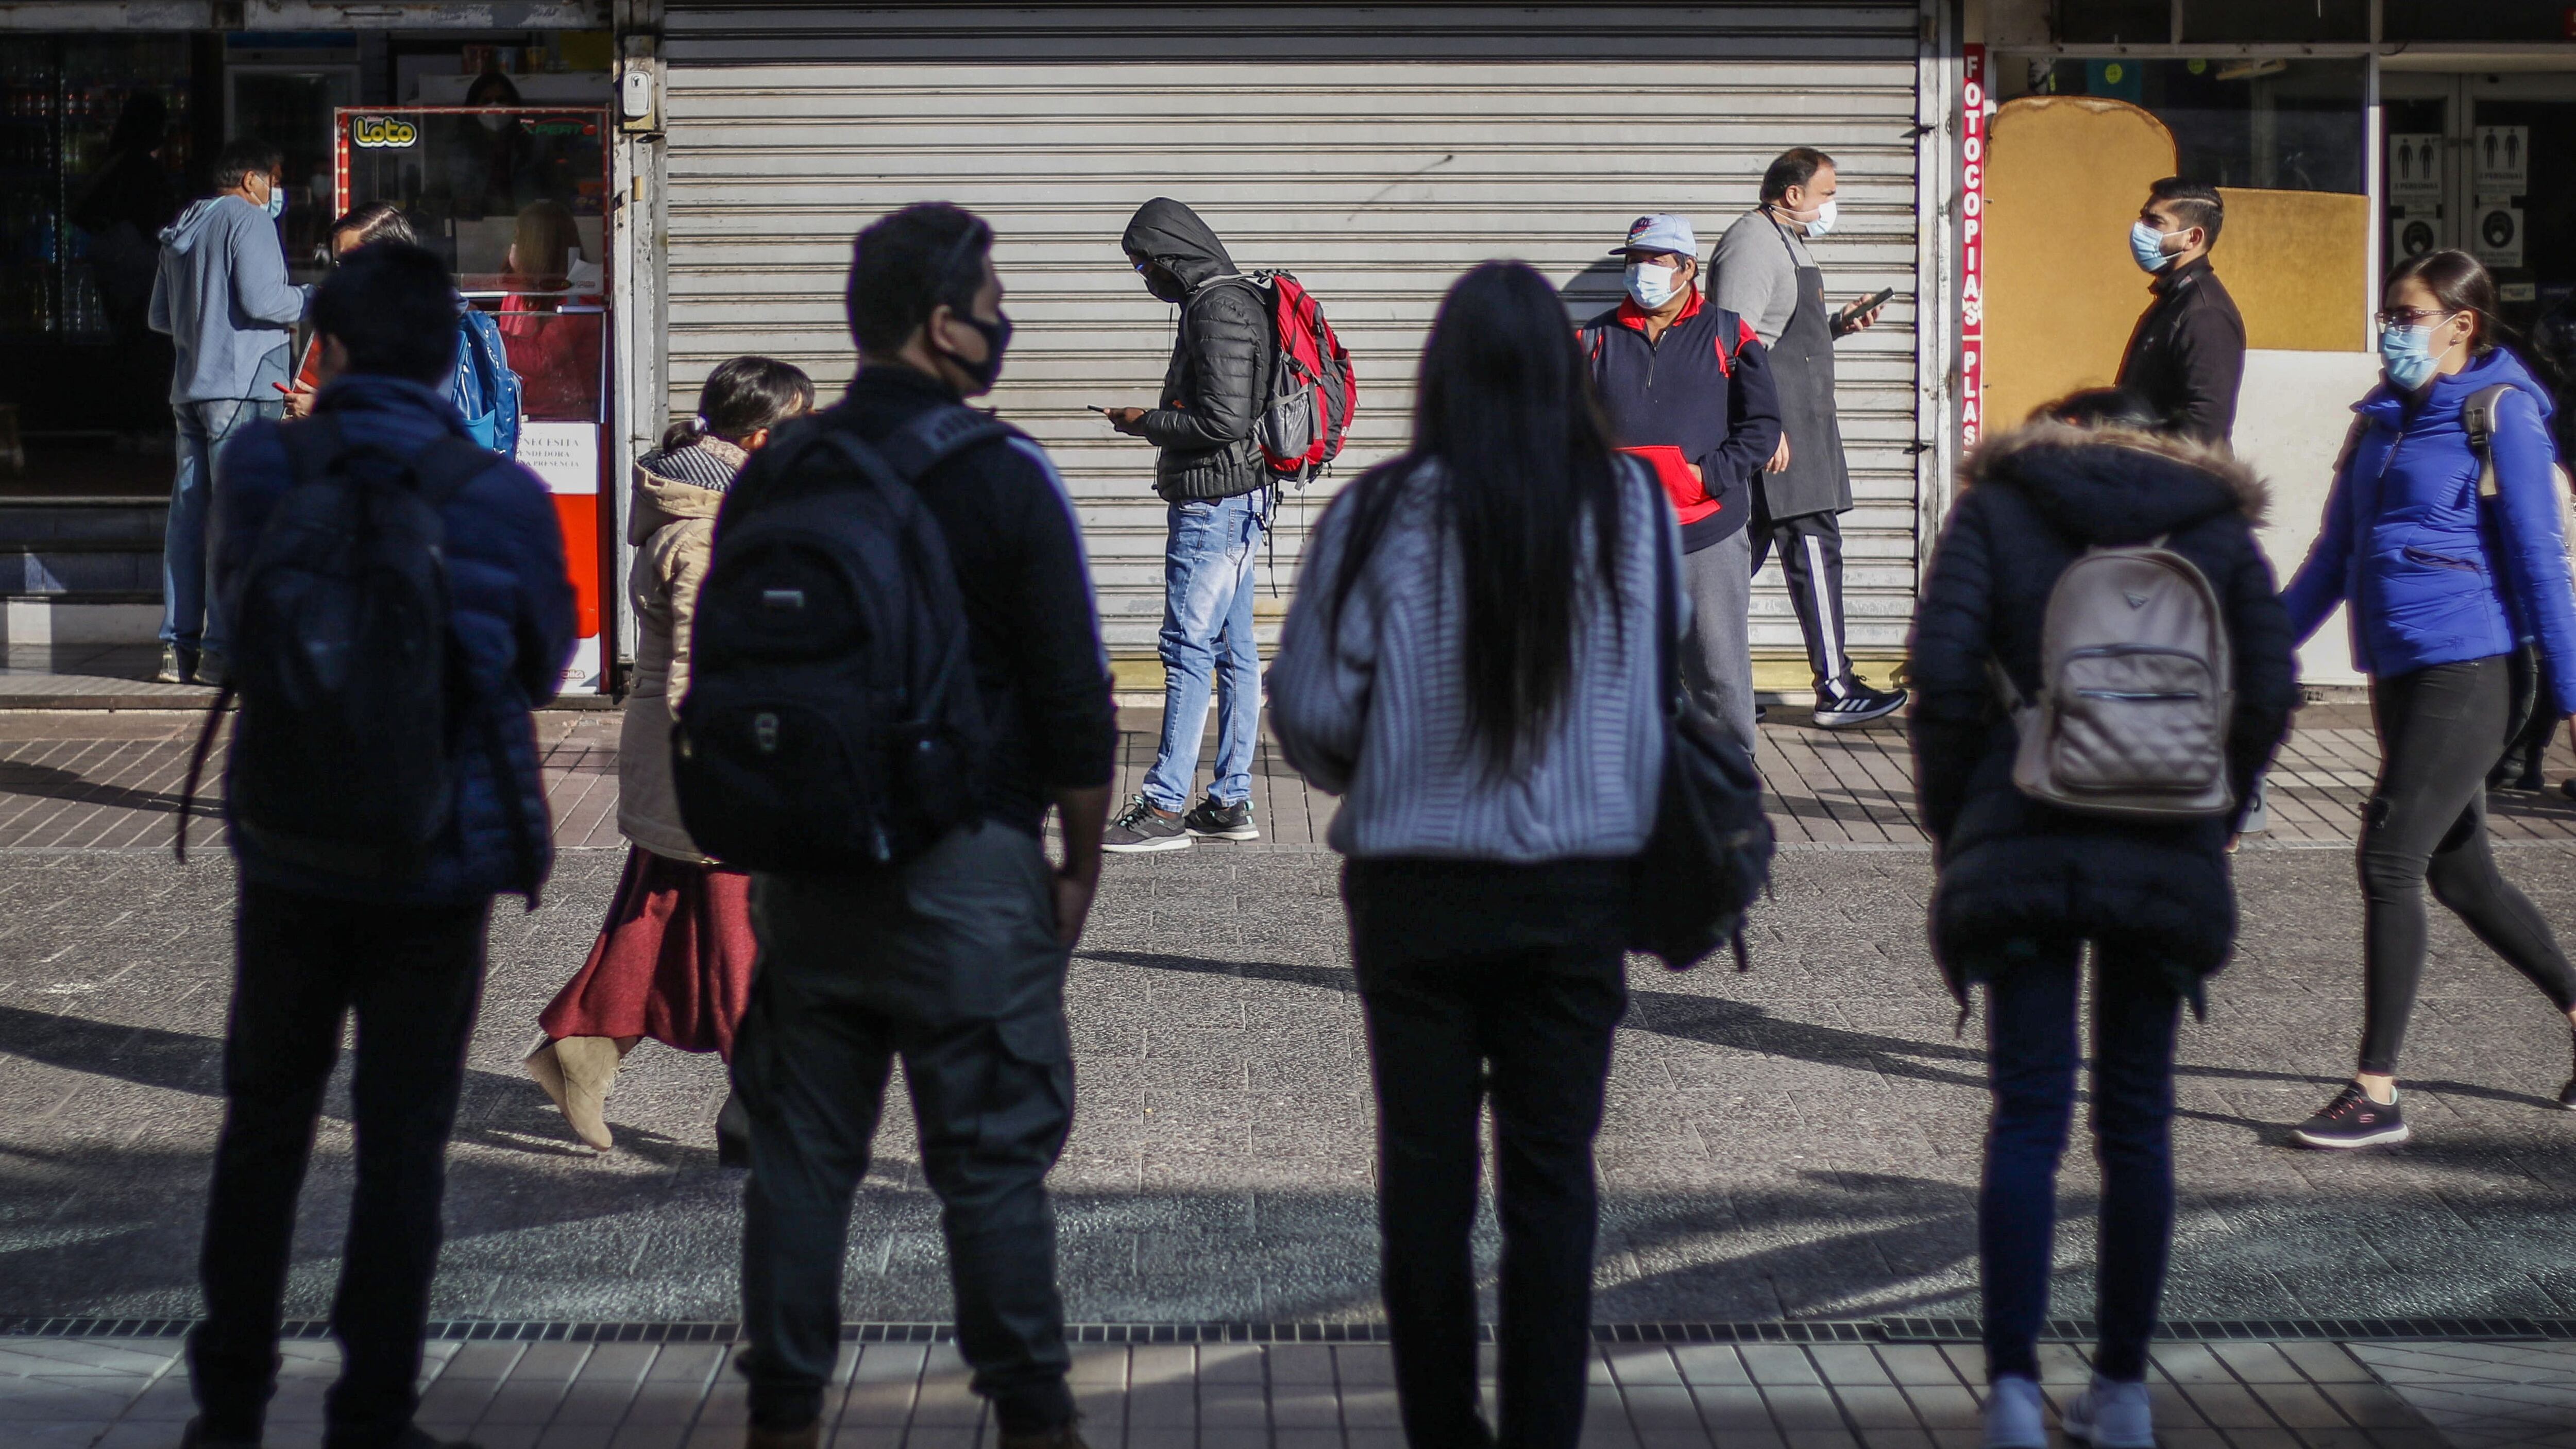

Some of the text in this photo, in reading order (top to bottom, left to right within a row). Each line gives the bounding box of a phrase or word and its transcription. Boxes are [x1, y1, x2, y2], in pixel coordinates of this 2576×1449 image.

[356, 119, 414, 143] Loto
[1963, 56, 1981, 326] FOTOCOPIAS
[523, 438, 579, 447] NECESITA
